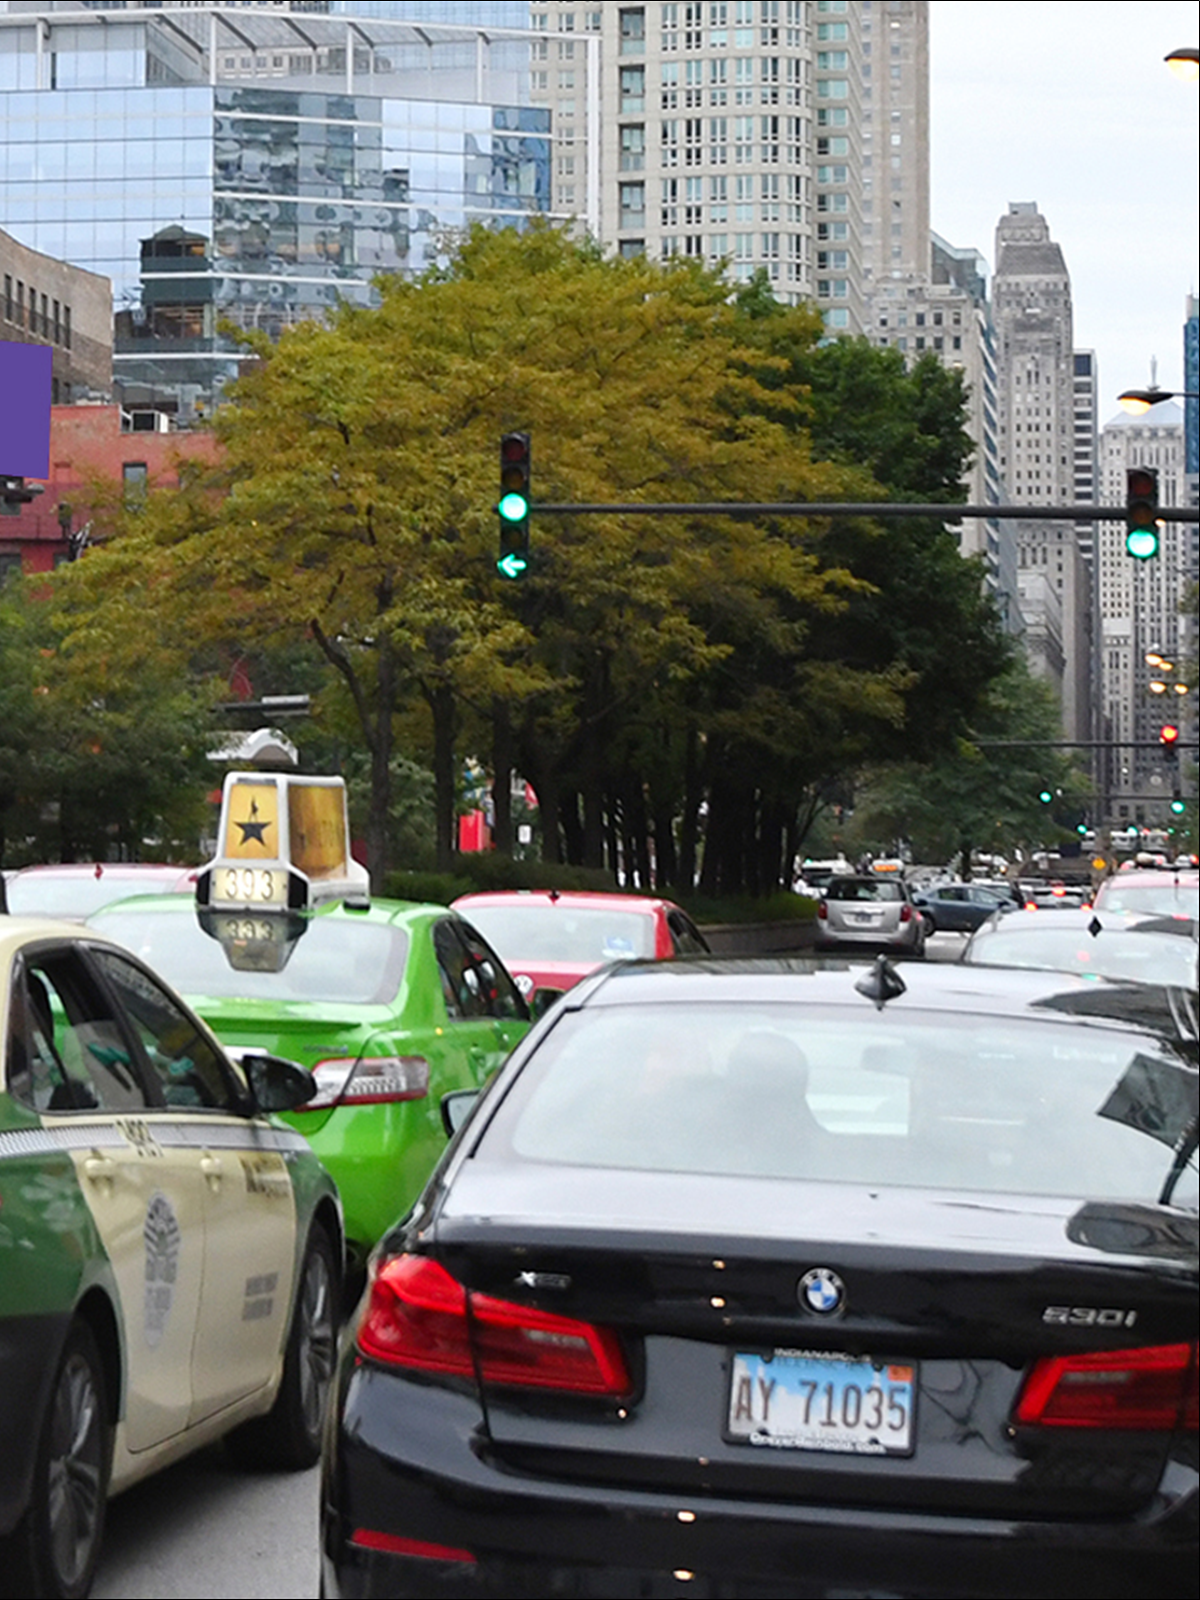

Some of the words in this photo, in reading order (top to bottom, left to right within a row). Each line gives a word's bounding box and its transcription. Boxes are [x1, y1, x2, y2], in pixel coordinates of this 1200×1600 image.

[225, 868, 275, 900] 393
[735, 1376, 776, 1421] AY
[800, 1379, 906, 1431] 71035
